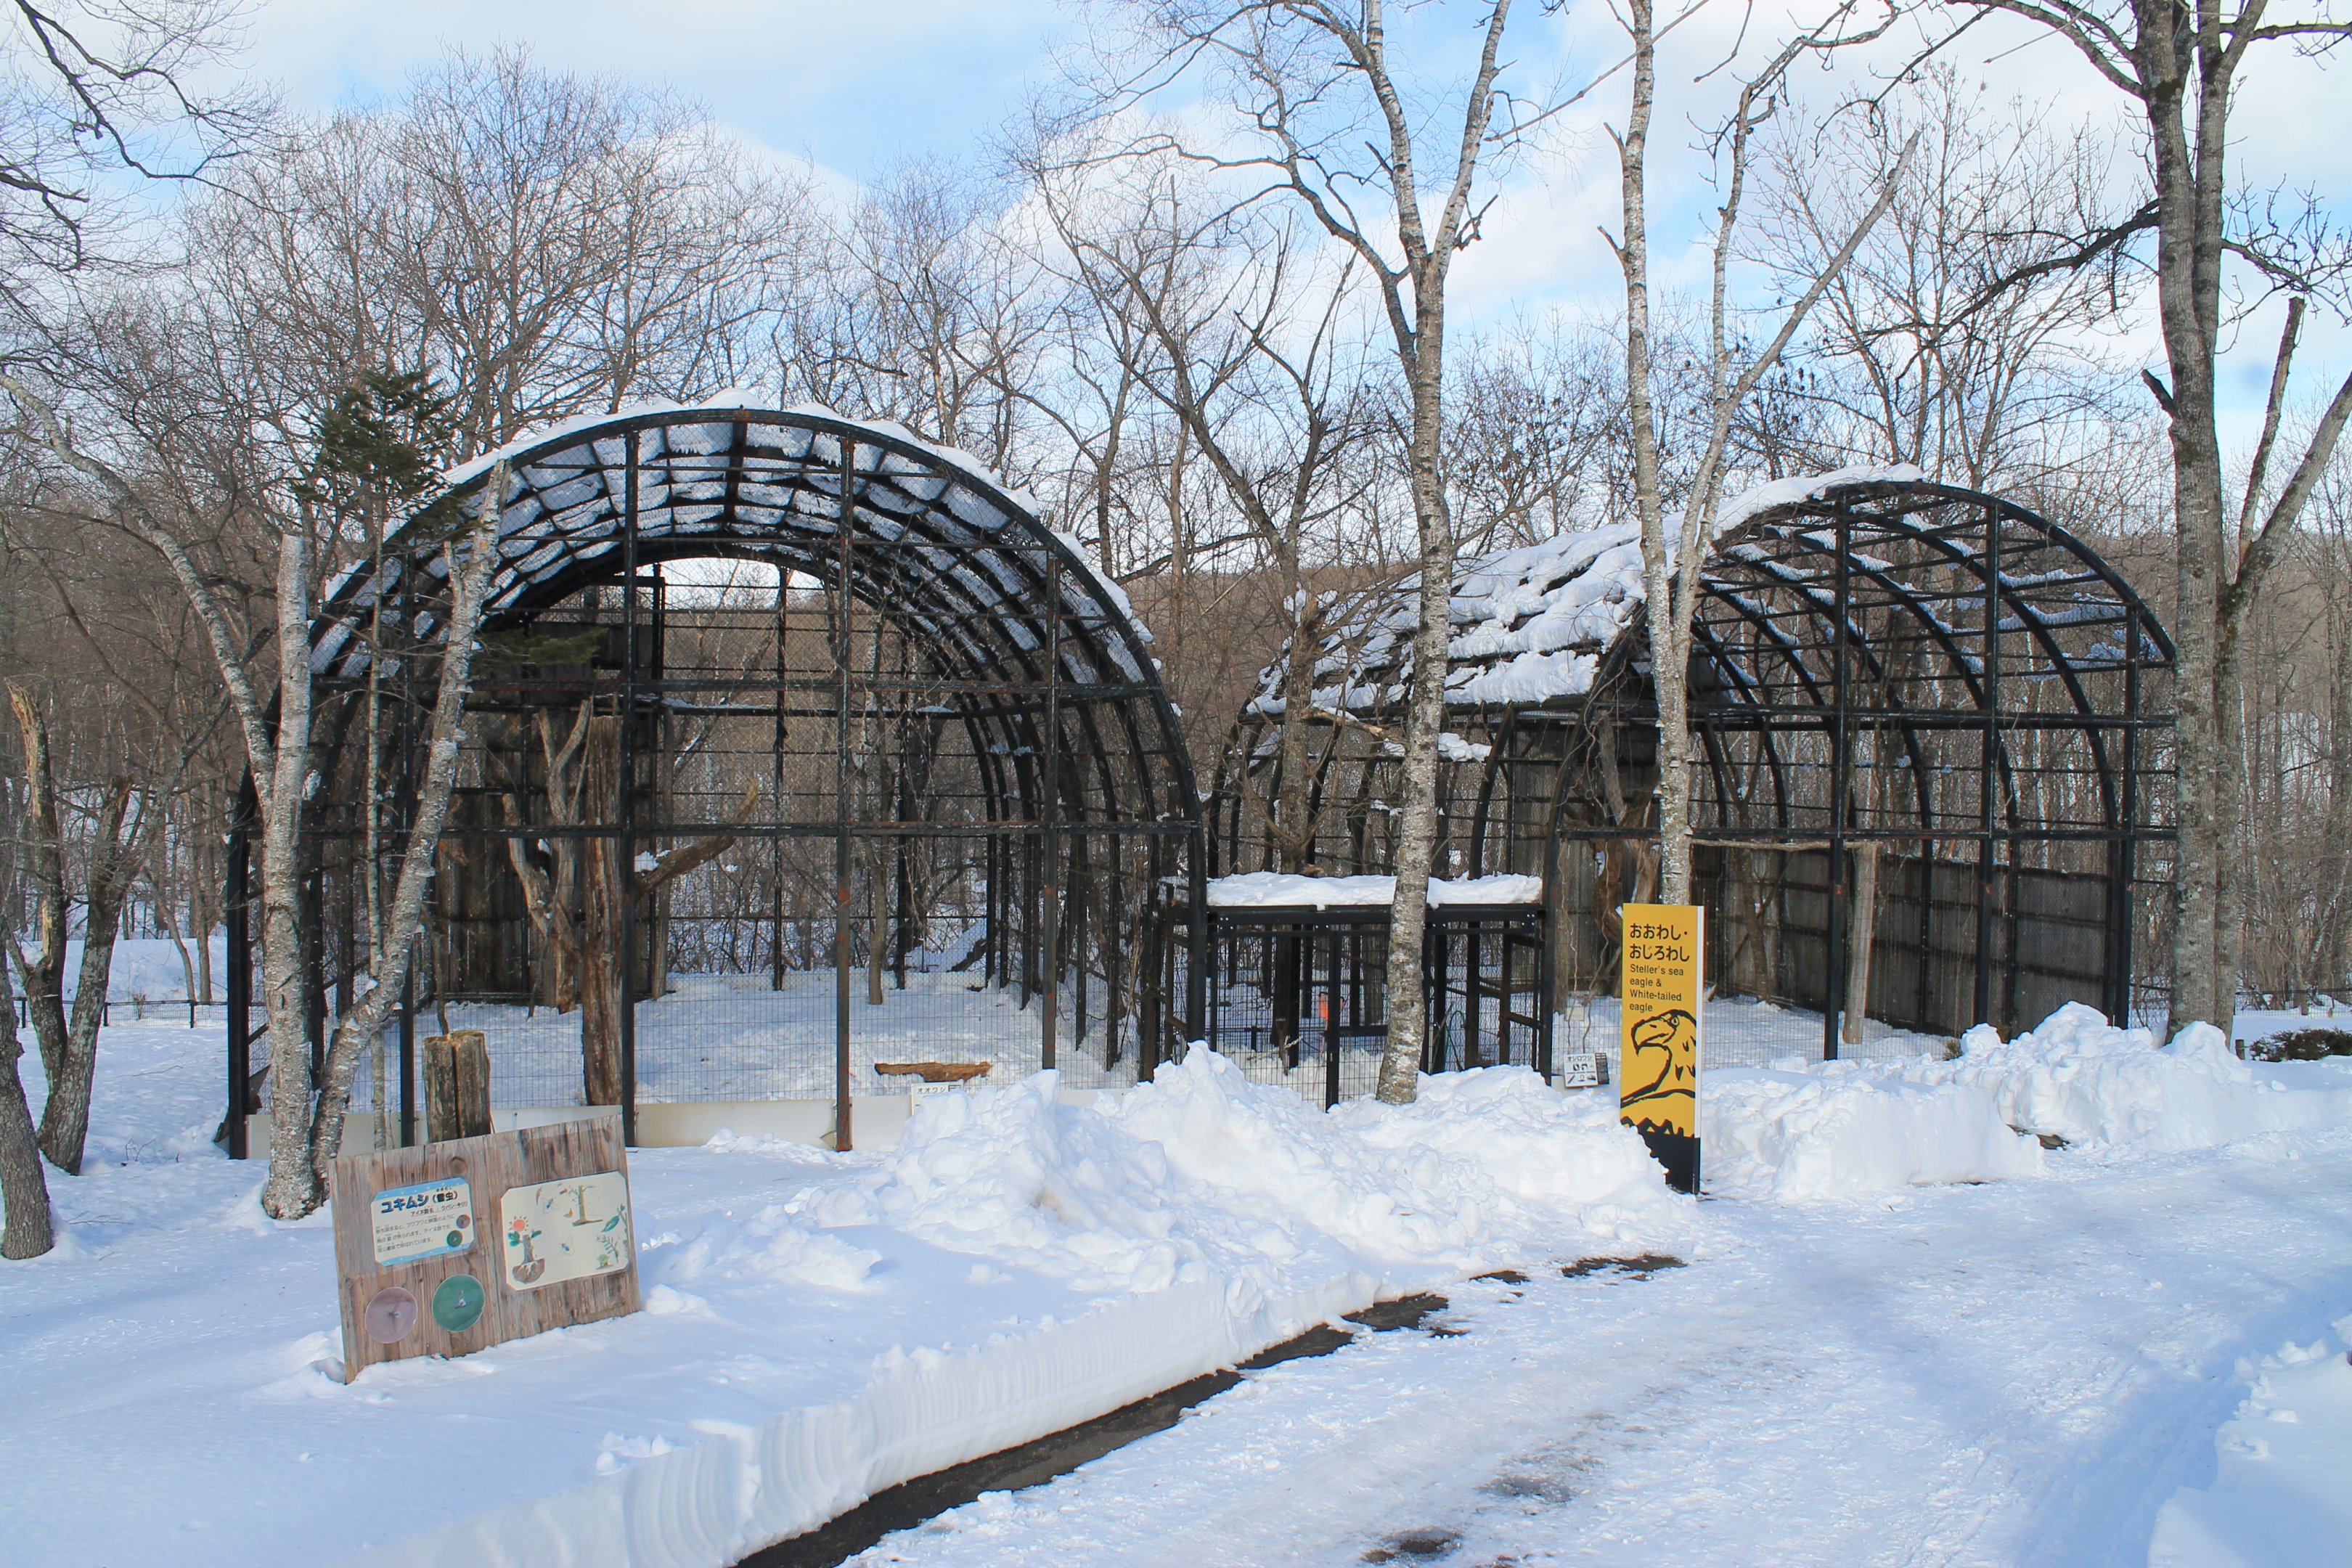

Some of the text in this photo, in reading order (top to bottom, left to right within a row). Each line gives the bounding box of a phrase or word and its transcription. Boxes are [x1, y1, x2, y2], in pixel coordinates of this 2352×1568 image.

[1630, 944, 1690, 962] おじろわし
[1630, 963, 1666, 975] Steller's
[1630, 978, 1662, 987] eagle &
[1630, 989, 1682, 1001] White-tailed
[1629, 1003, 1653, 1013] eagle
[381, 1194, 429, 1214] ユキムシ
